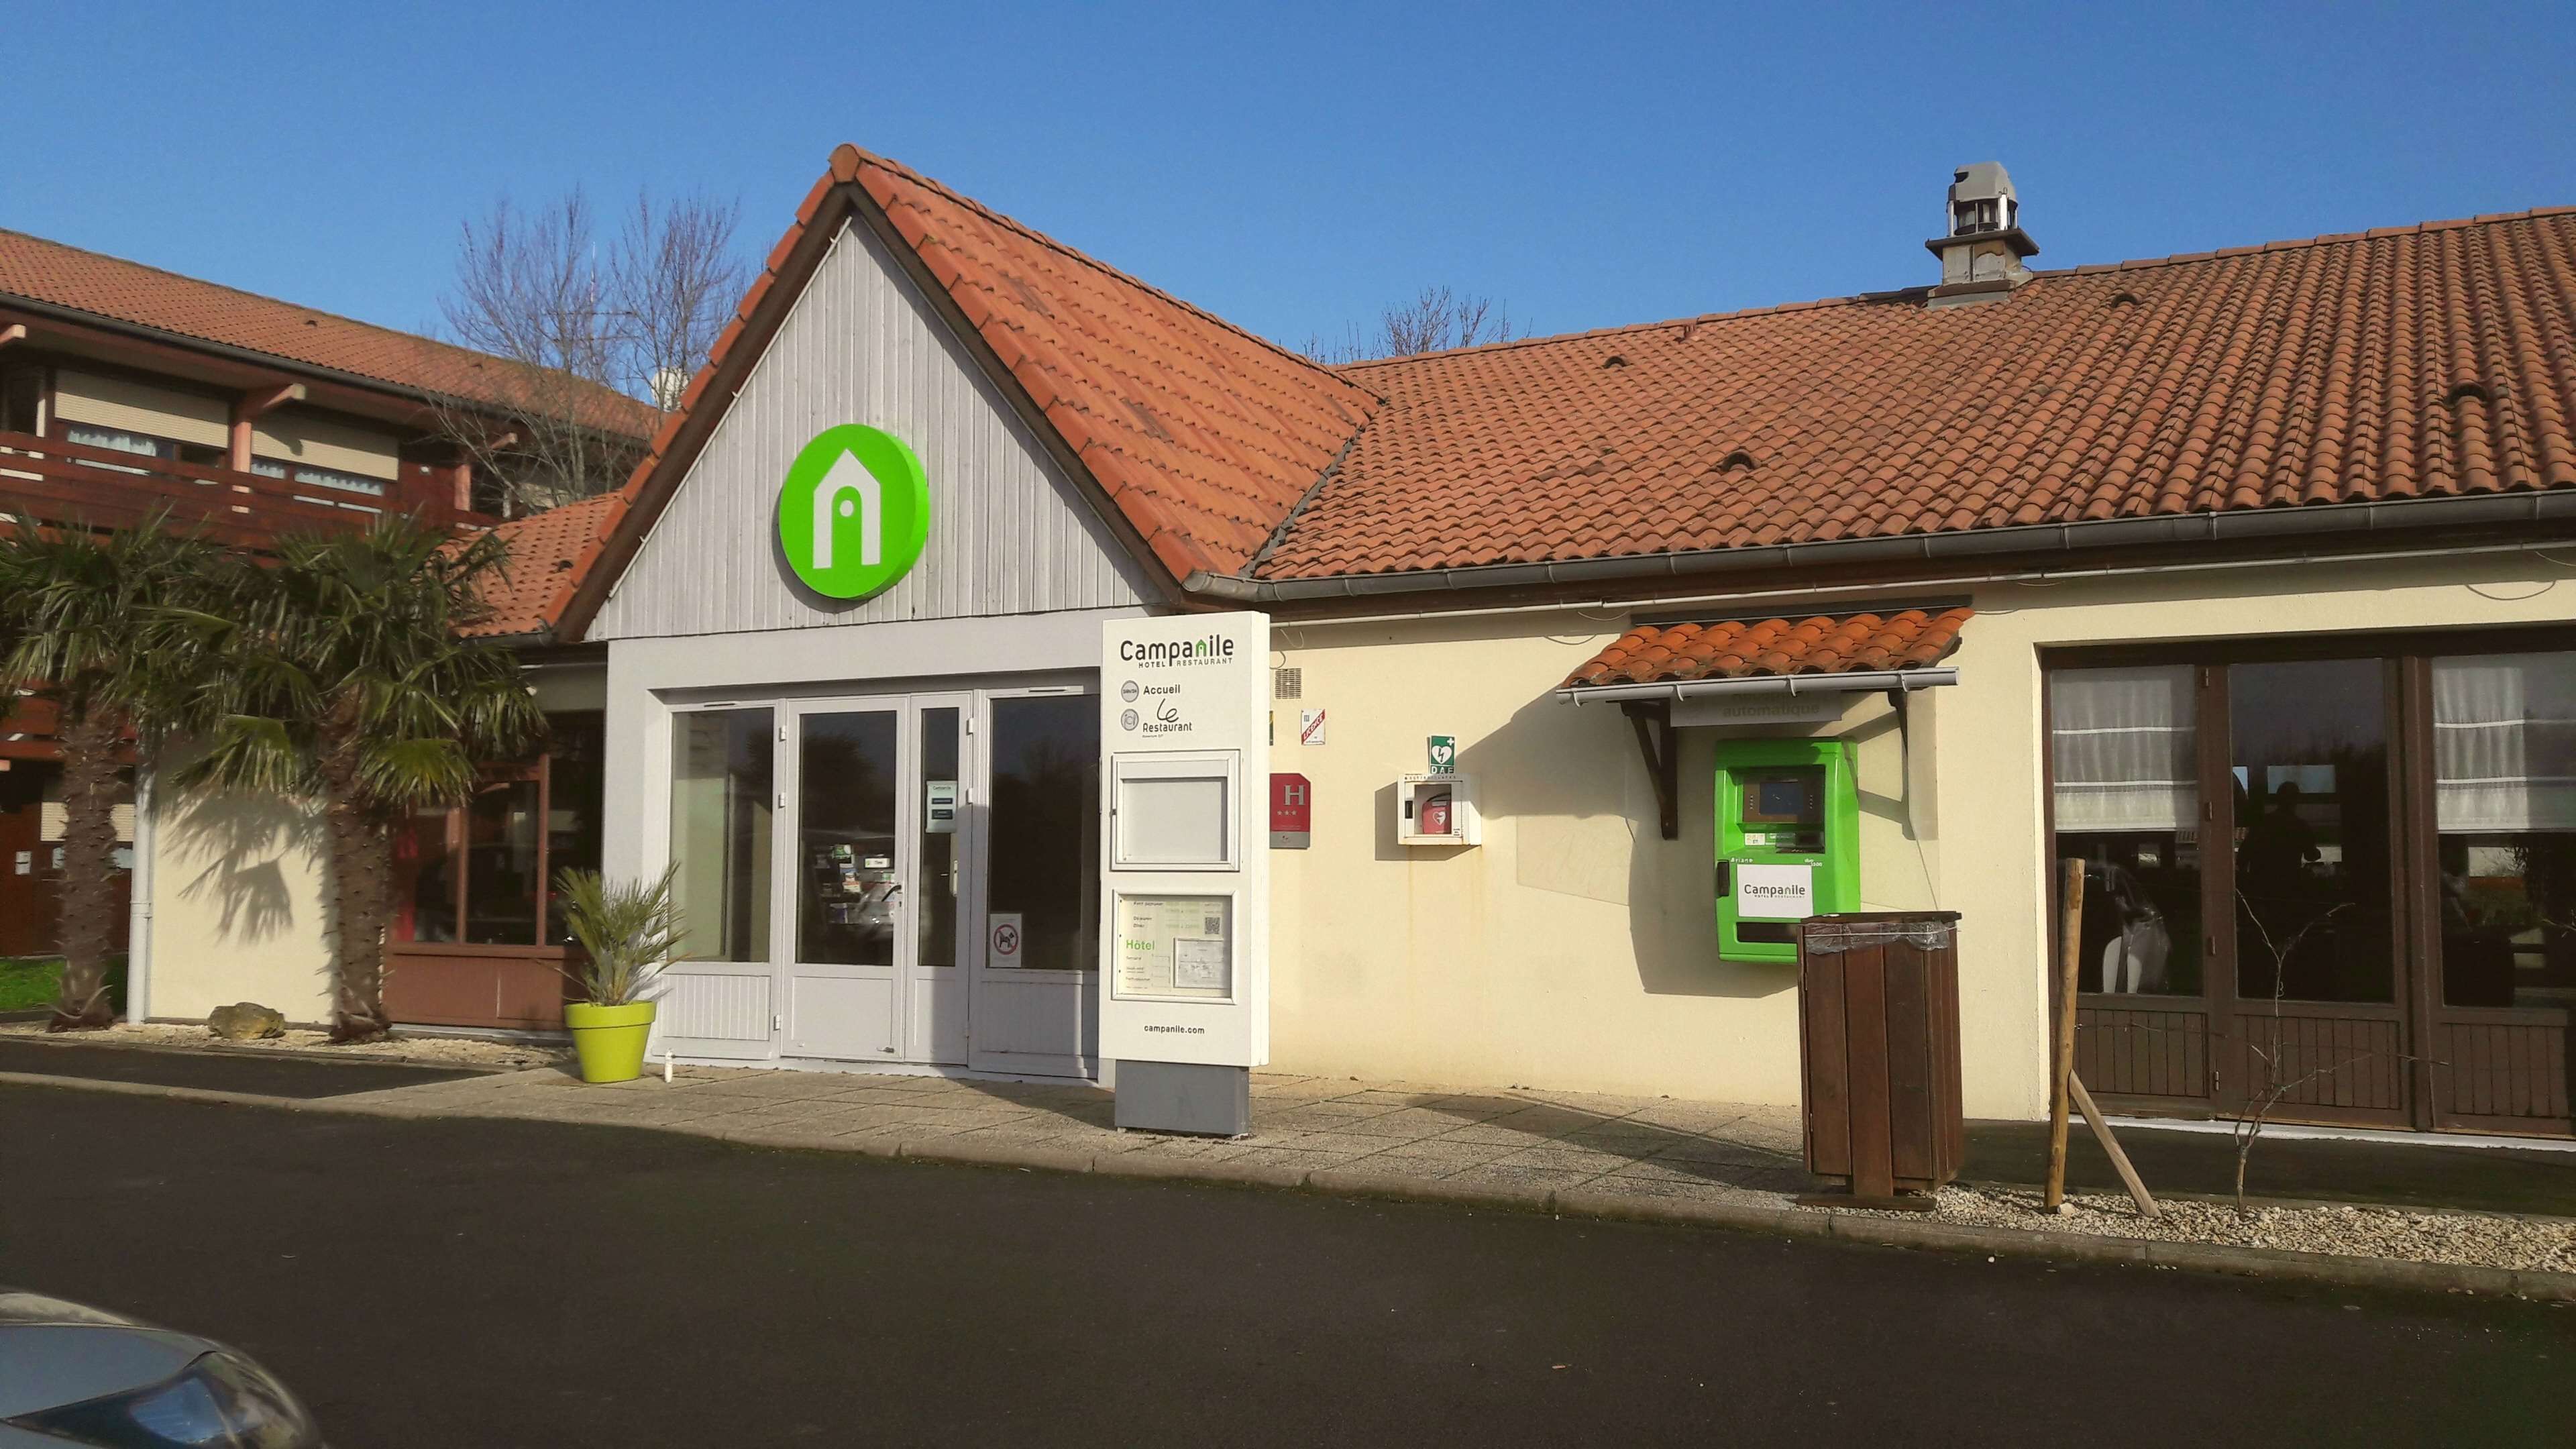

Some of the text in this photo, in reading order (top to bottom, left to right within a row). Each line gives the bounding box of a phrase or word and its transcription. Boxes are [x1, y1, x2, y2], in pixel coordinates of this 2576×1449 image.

[1120, 634, 1234, 667] Campanile
[1177, 657, 1232, 666] RESTAURANT
[1143, 684, 1181, 695] Accueil
[1142, 722, 1192, 733] Restaurant
[1431, 766, 1454, 774] DAE
[1284, 785, 1305, 806] H
[1744, 884, 1806, 898] Campanile
[1126, 939, 1155, 951] Hôtel
[1144, 1024, 1205, 1035] campanile.com
